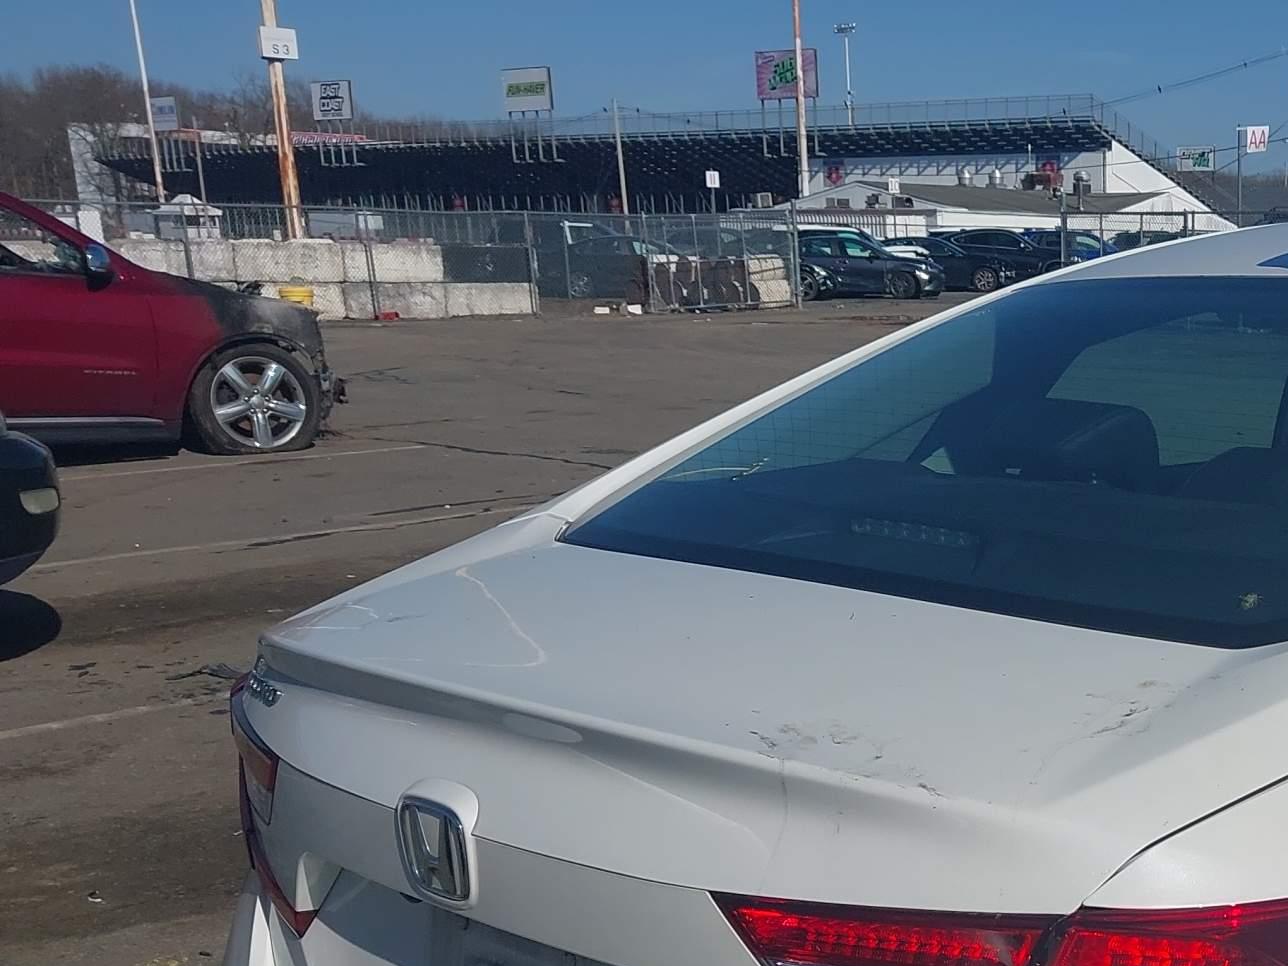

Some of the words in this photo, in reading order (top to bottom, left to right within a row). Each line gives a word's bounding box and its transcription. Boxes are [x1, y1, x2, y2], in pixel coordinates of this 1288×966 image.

[321, 83, 340, 97] EAST
[320, 98, 343, 111] COAST
[1248, 129, 1267, 149] AA
